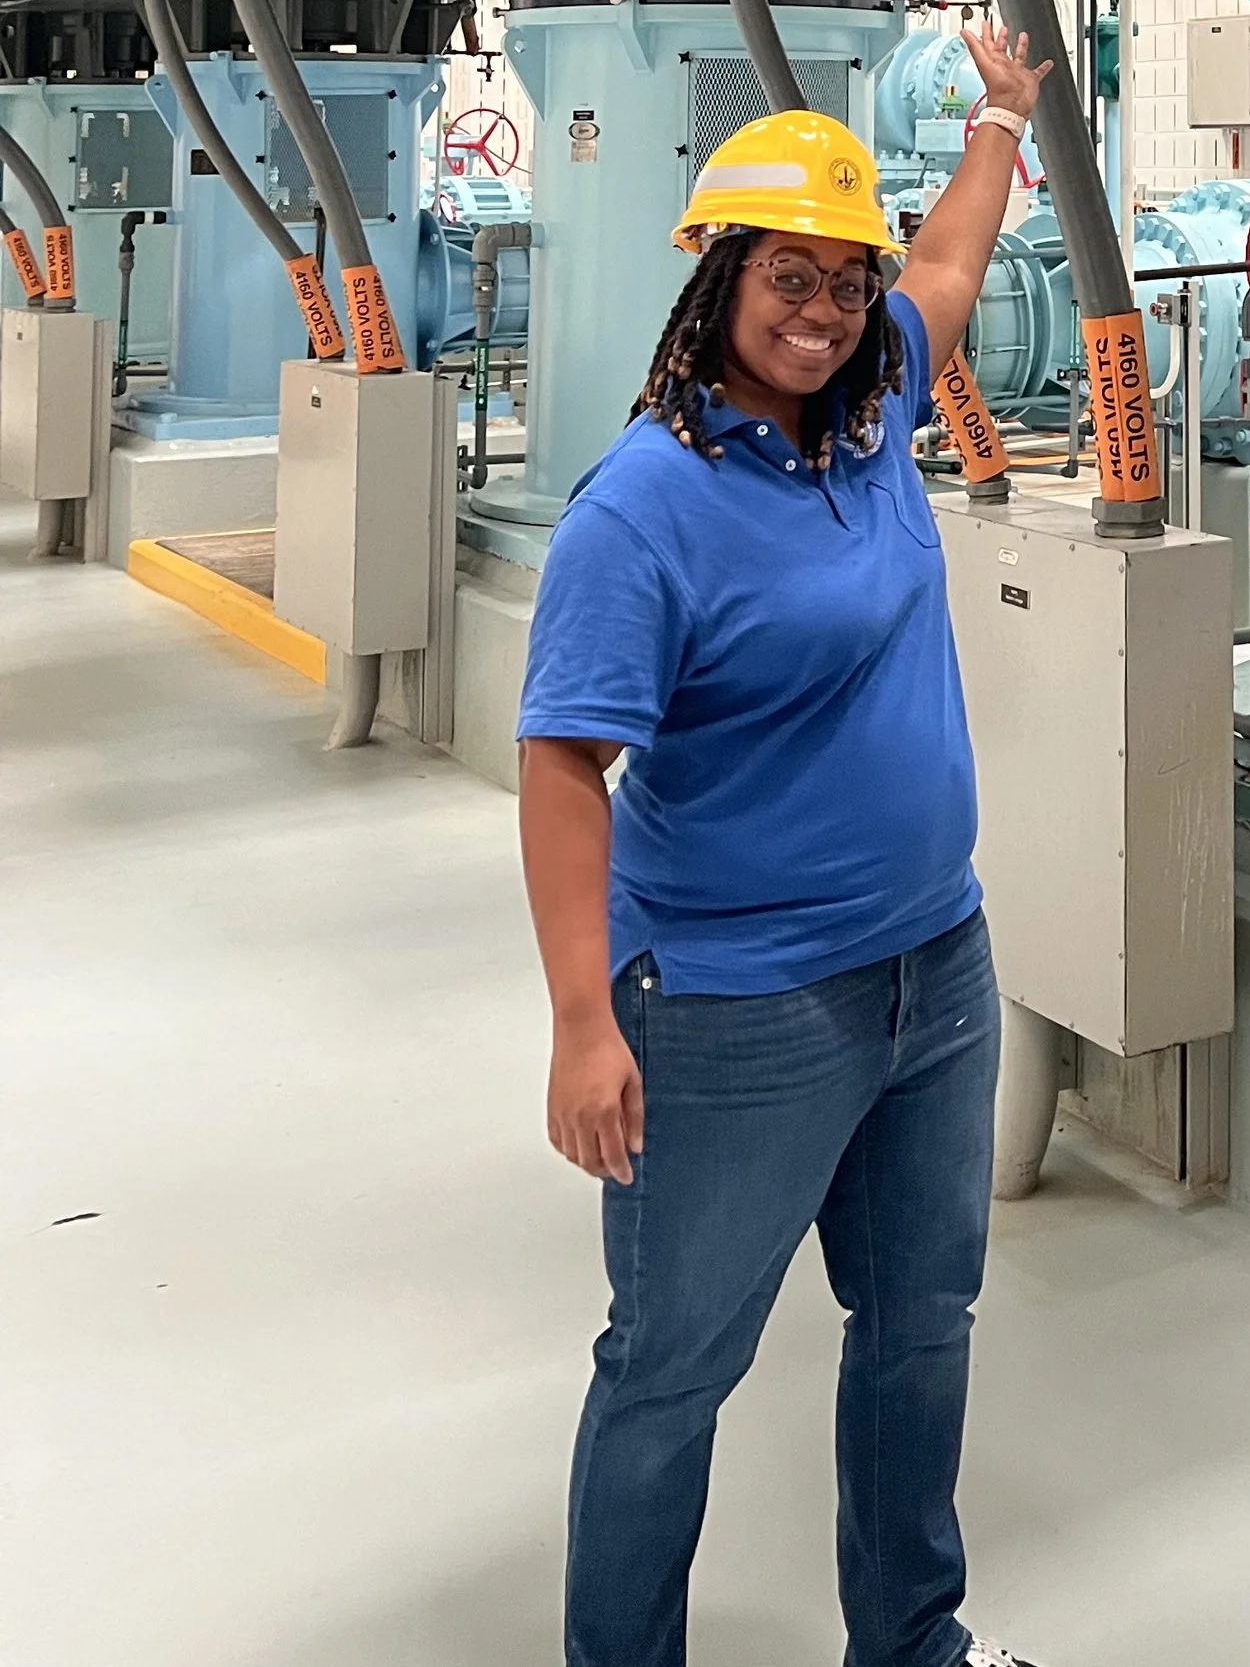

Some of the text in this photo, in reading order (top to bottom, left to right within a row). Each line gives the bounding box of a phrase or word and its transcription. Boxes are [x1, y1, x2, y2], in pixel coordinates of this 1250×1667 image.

[21, 256, 39, 288] VOLTS
[46, 235, 56, 267] VOLTS
[61, 256, 71, 290] VOLTS
[295, 271, 314, 300] 4160
[308, 301, 333, 347] VOLTS
[353, 277, 375, 361] 4160 VOLTS
[373, 275, 395, 359] 4160 VOLTS
[943, 359, 971, 412] VOL
[1117, 333, 1150, 482] 4160 VOLTS
[962, 411, 993, 459] 4160
